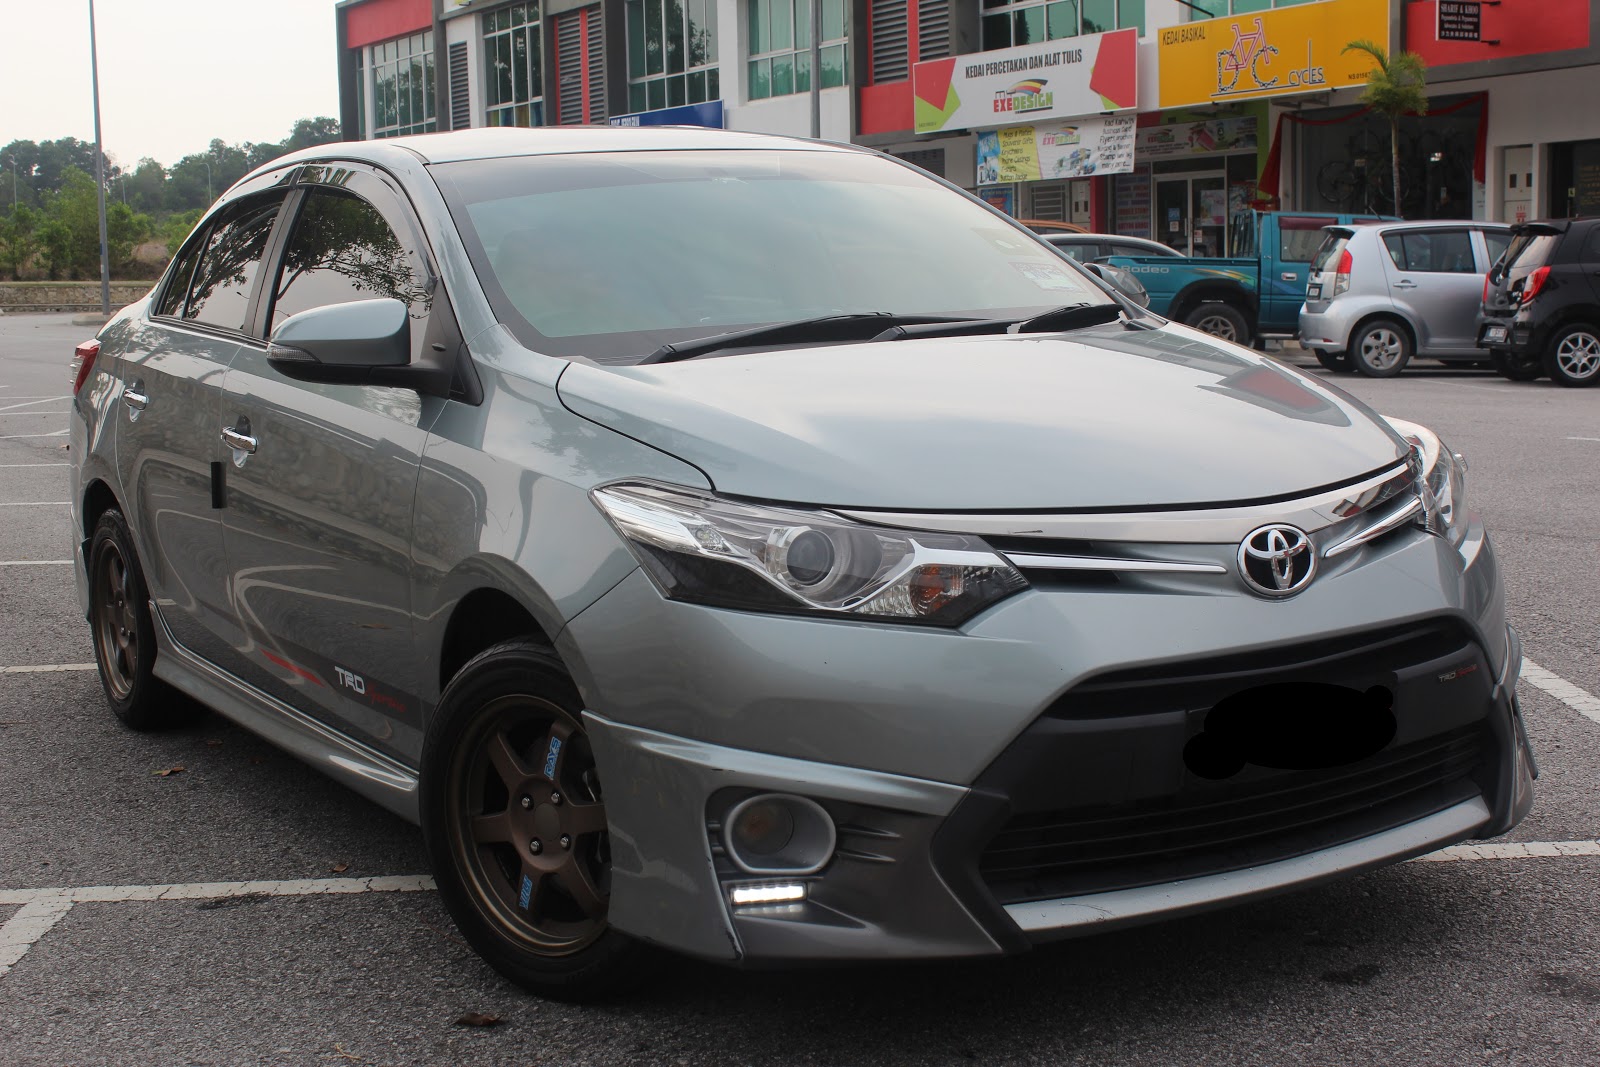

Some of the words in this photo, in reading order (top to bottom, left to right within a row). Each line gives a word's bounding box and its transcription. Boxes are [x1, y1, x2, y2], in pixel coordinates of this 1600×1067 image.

[1162, 29, 1180, 46] KEDAI
[1181, 26, 1206, 43] BASIKAL
[965, 64, 985, 79] KEDAI
[986, 57, 1028, 76] PERCETAKAN
[1029, 55, 1043, 70] DAN
[1044, 52, 1061, 67] ALAT
[1062, 49, 1083, 64] TULIS
[993, 92, 1053, 112] EXEDESIGN
[1121, 265, 1169, 274] Rodeo
[334, 665, 366, 695] TRD
[543, 736, 562, 781] RAYS
